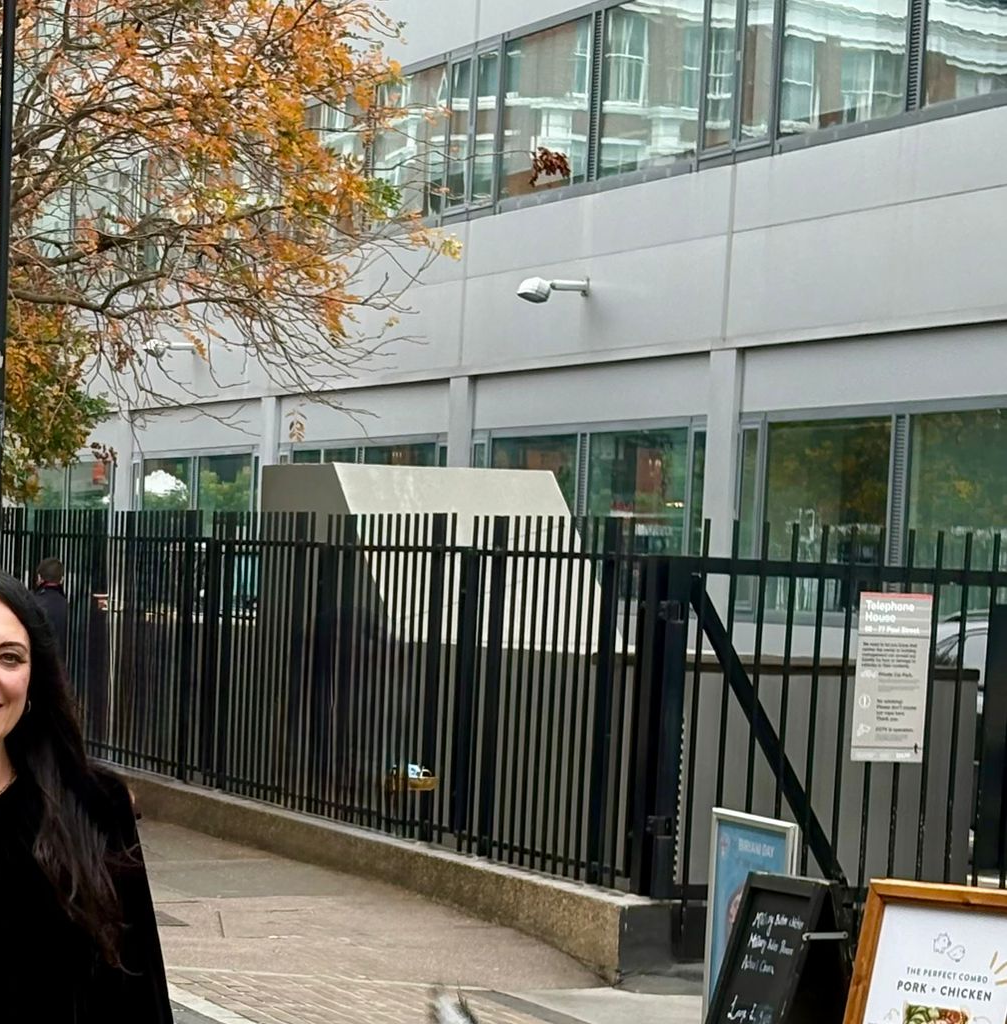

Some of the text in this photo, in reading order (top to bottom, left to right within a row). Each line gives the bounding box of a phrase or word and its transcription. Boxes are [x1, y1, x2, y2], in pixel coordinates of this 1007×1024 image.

[865, 600, 915, 613] Telephone
[865, 611, 897, 623] House
[907, 966, 988, 984] THE PERFECT COMBO
[897, 980, 928, 993] PORK
[940, 986, 992, 1001] CHICKEN
